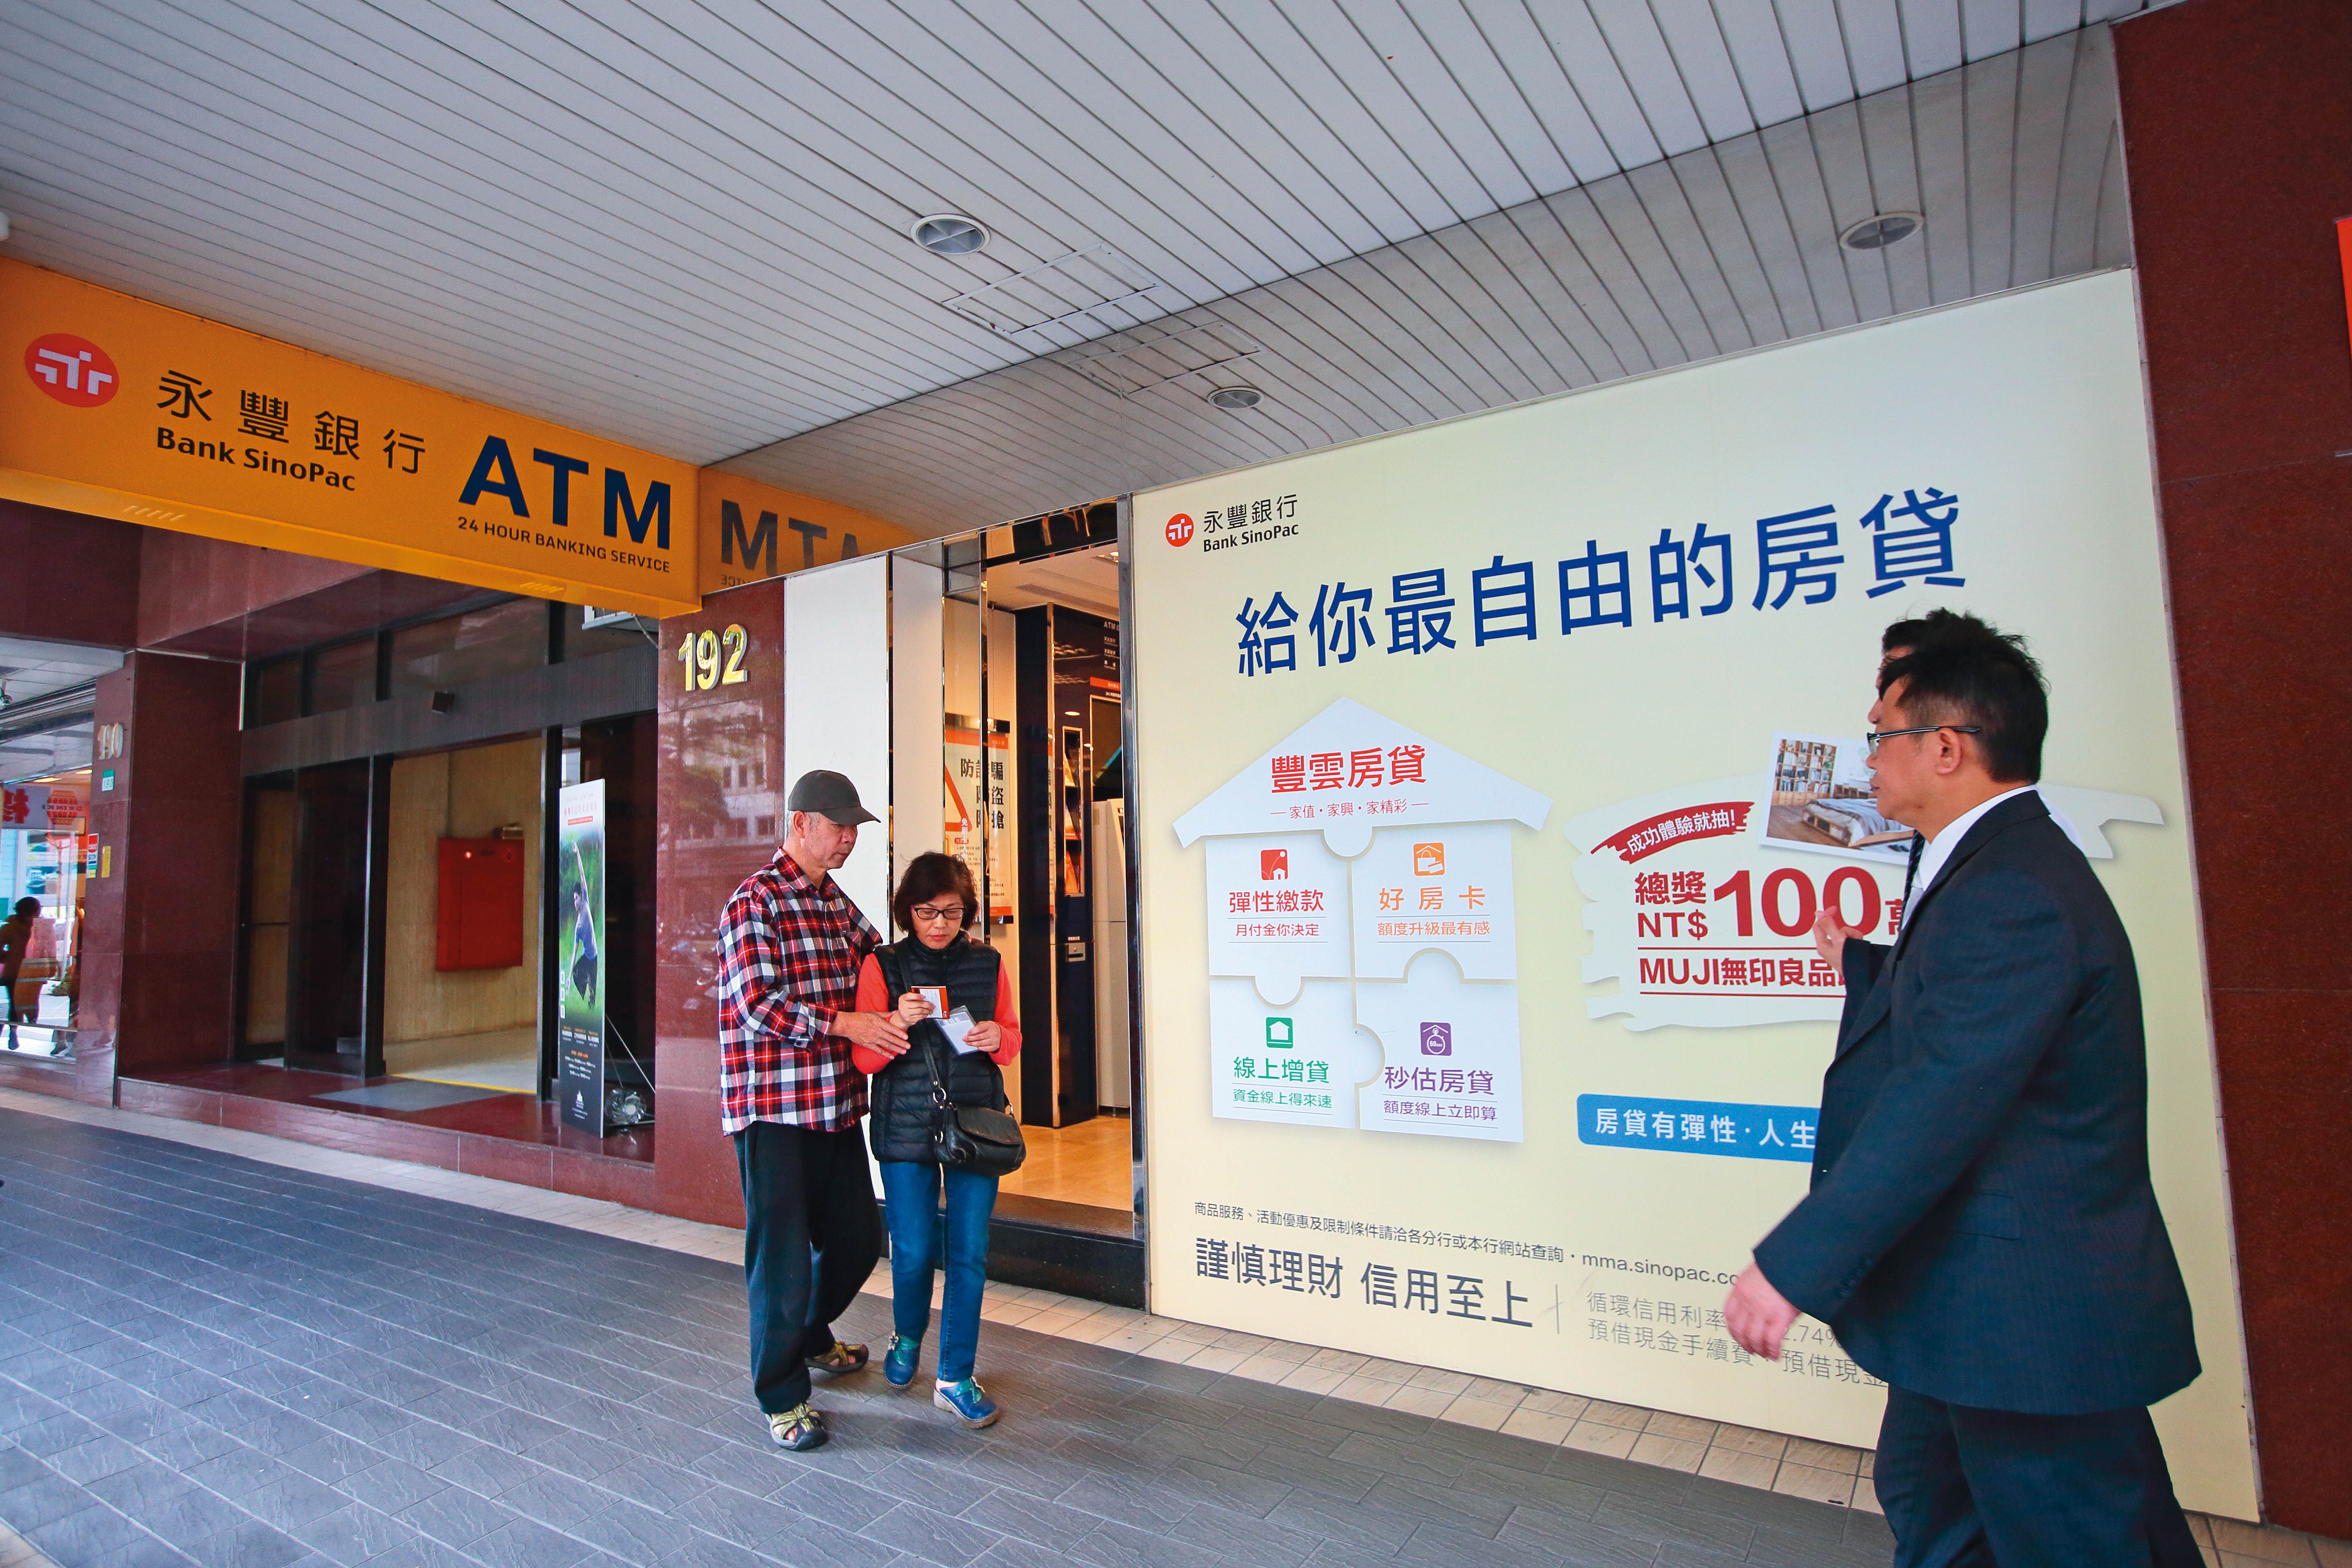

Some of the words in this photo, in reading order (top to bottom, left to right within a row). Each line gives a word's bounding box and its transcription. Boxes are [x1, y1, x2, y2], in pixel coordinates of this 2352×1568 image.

[157, 370, 425, 474] 永豐銀行
[157, 426, 235, 465] Bank
[243, 448, 355, 491] SinoPac
[458, 434, 671, 550] ATM
[1204, 494, 1298, 533] 永豐銀行
[458, 517, 479, 532] 24
[484, 521, 530, 543] HOUR
[535, 533, 606, 560] BANKING
[611, 550, 670, 573] SERVICE
[1203, 535, 1238, 552] Bank
[1241, 524, 1298, 545] SinoPac
[1236, 487, 1966, 677] 給你最自由的房貸
[678, 624, 748, 691] 192
[98, 722, 123, 760] 190
[1270, 744, 1427, 794] 豐雲房貸
[1627, 808, 1736, 856] 成功體驗就抽!
[1229, 889, 1324, 913] 彈性繳款
[1379, 884, 1486, 911] 好房卡
[1635, 871, 1707, 906] 總獎
[1236, 923, 1319, 937] 月付金你決定
[1378, 921, 1490, 936] 額度升級最有感
[1637, 909, 1708, 940] NT$
[1640, 958, 1846, 987] MUJI無印良品
[1233, 1056, 1330, 1084] 線上增貸
[1384, 1066, 1494, 1096] 秒估房貸
[1232, 1088, 1332, 1109] 資金線上得來速
[1383, 1100, 1498, 1121] 額度線上立即算
[1196, 1237, 1344, 1299] 謹慎理財
[1361, 1262, 1533, 1327] 信用至上
